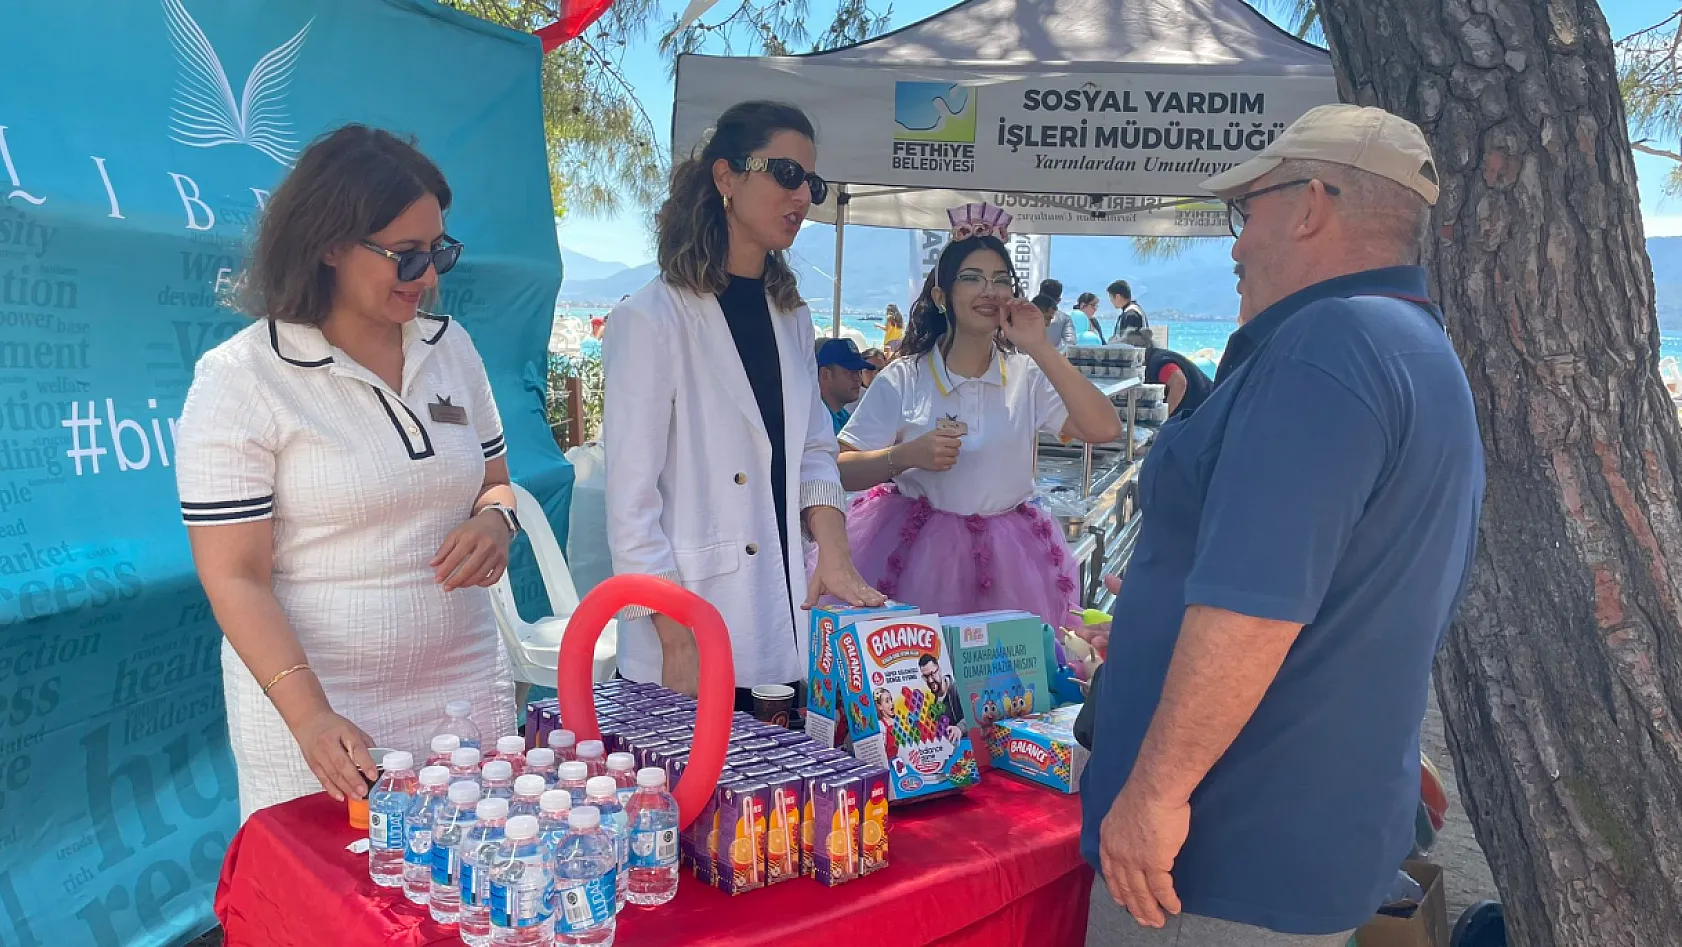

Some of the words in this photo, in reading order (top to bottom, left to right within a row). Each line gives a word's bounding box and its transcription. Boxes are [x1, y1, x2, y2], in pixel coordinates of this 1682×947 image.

[1023, 89, 1139, 114] SOSYAL
[1144, 91, 1265, 114] YARDIM
[998, 119, 1088, 153] İŞLERİ
[1033, 153, 1136, 172] Yarınlardan
[1143, 156, 1242, 177] Umutluyu
[871, 627, 935, 657] BALANCE
[843, 636, 863, 691] BALANCE
[1010, 740, 1048, 763] BALANCE
